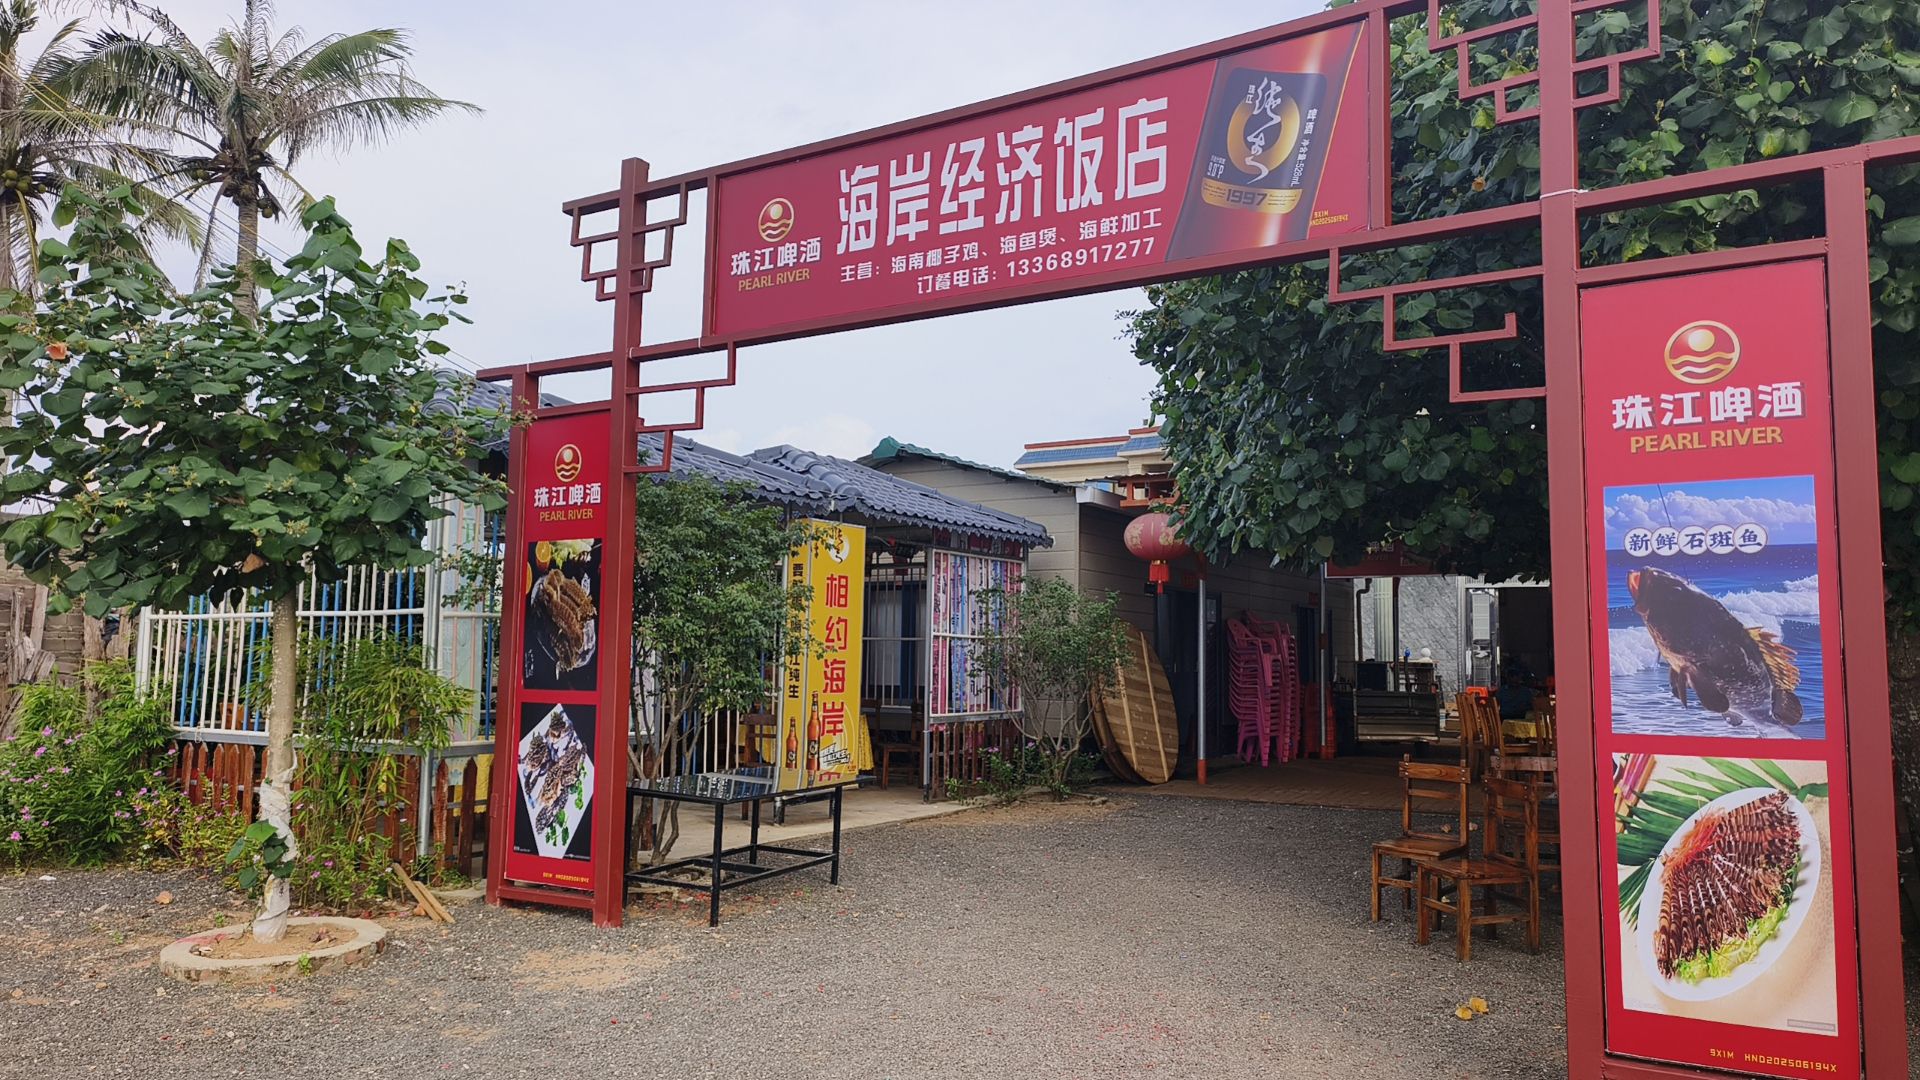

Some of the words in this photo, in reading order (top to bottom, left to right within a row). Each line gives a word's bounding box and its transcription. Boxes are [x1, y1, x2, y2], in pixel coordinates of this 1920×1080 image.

[837, 96, 1168, 255] 海岸经济饭店
[1225, 188, 1268, 206] 1997
[730, 236, 821, 276] 珠江啤酒
[738, 273, 774, 292] PEARL
[775, 268, 810, 287] RIVER
[1611, 382, 1803, 430] 珠江啤酒
[1630, 432, 1707, 453] PEARL
[1711, 426, 1783, 447] RIVER
[534, 482, 601, 508] 珠江啤酒
[539, 510, 566, 522] PEARL
[568, 508, 593, 520] RIVER
[1627, 528, 1763, 551] 新鲜石斑鱼
[820, 573, 849, 737] 相约海岸
[1710, 1048, 1735, 1060] 9X1M
